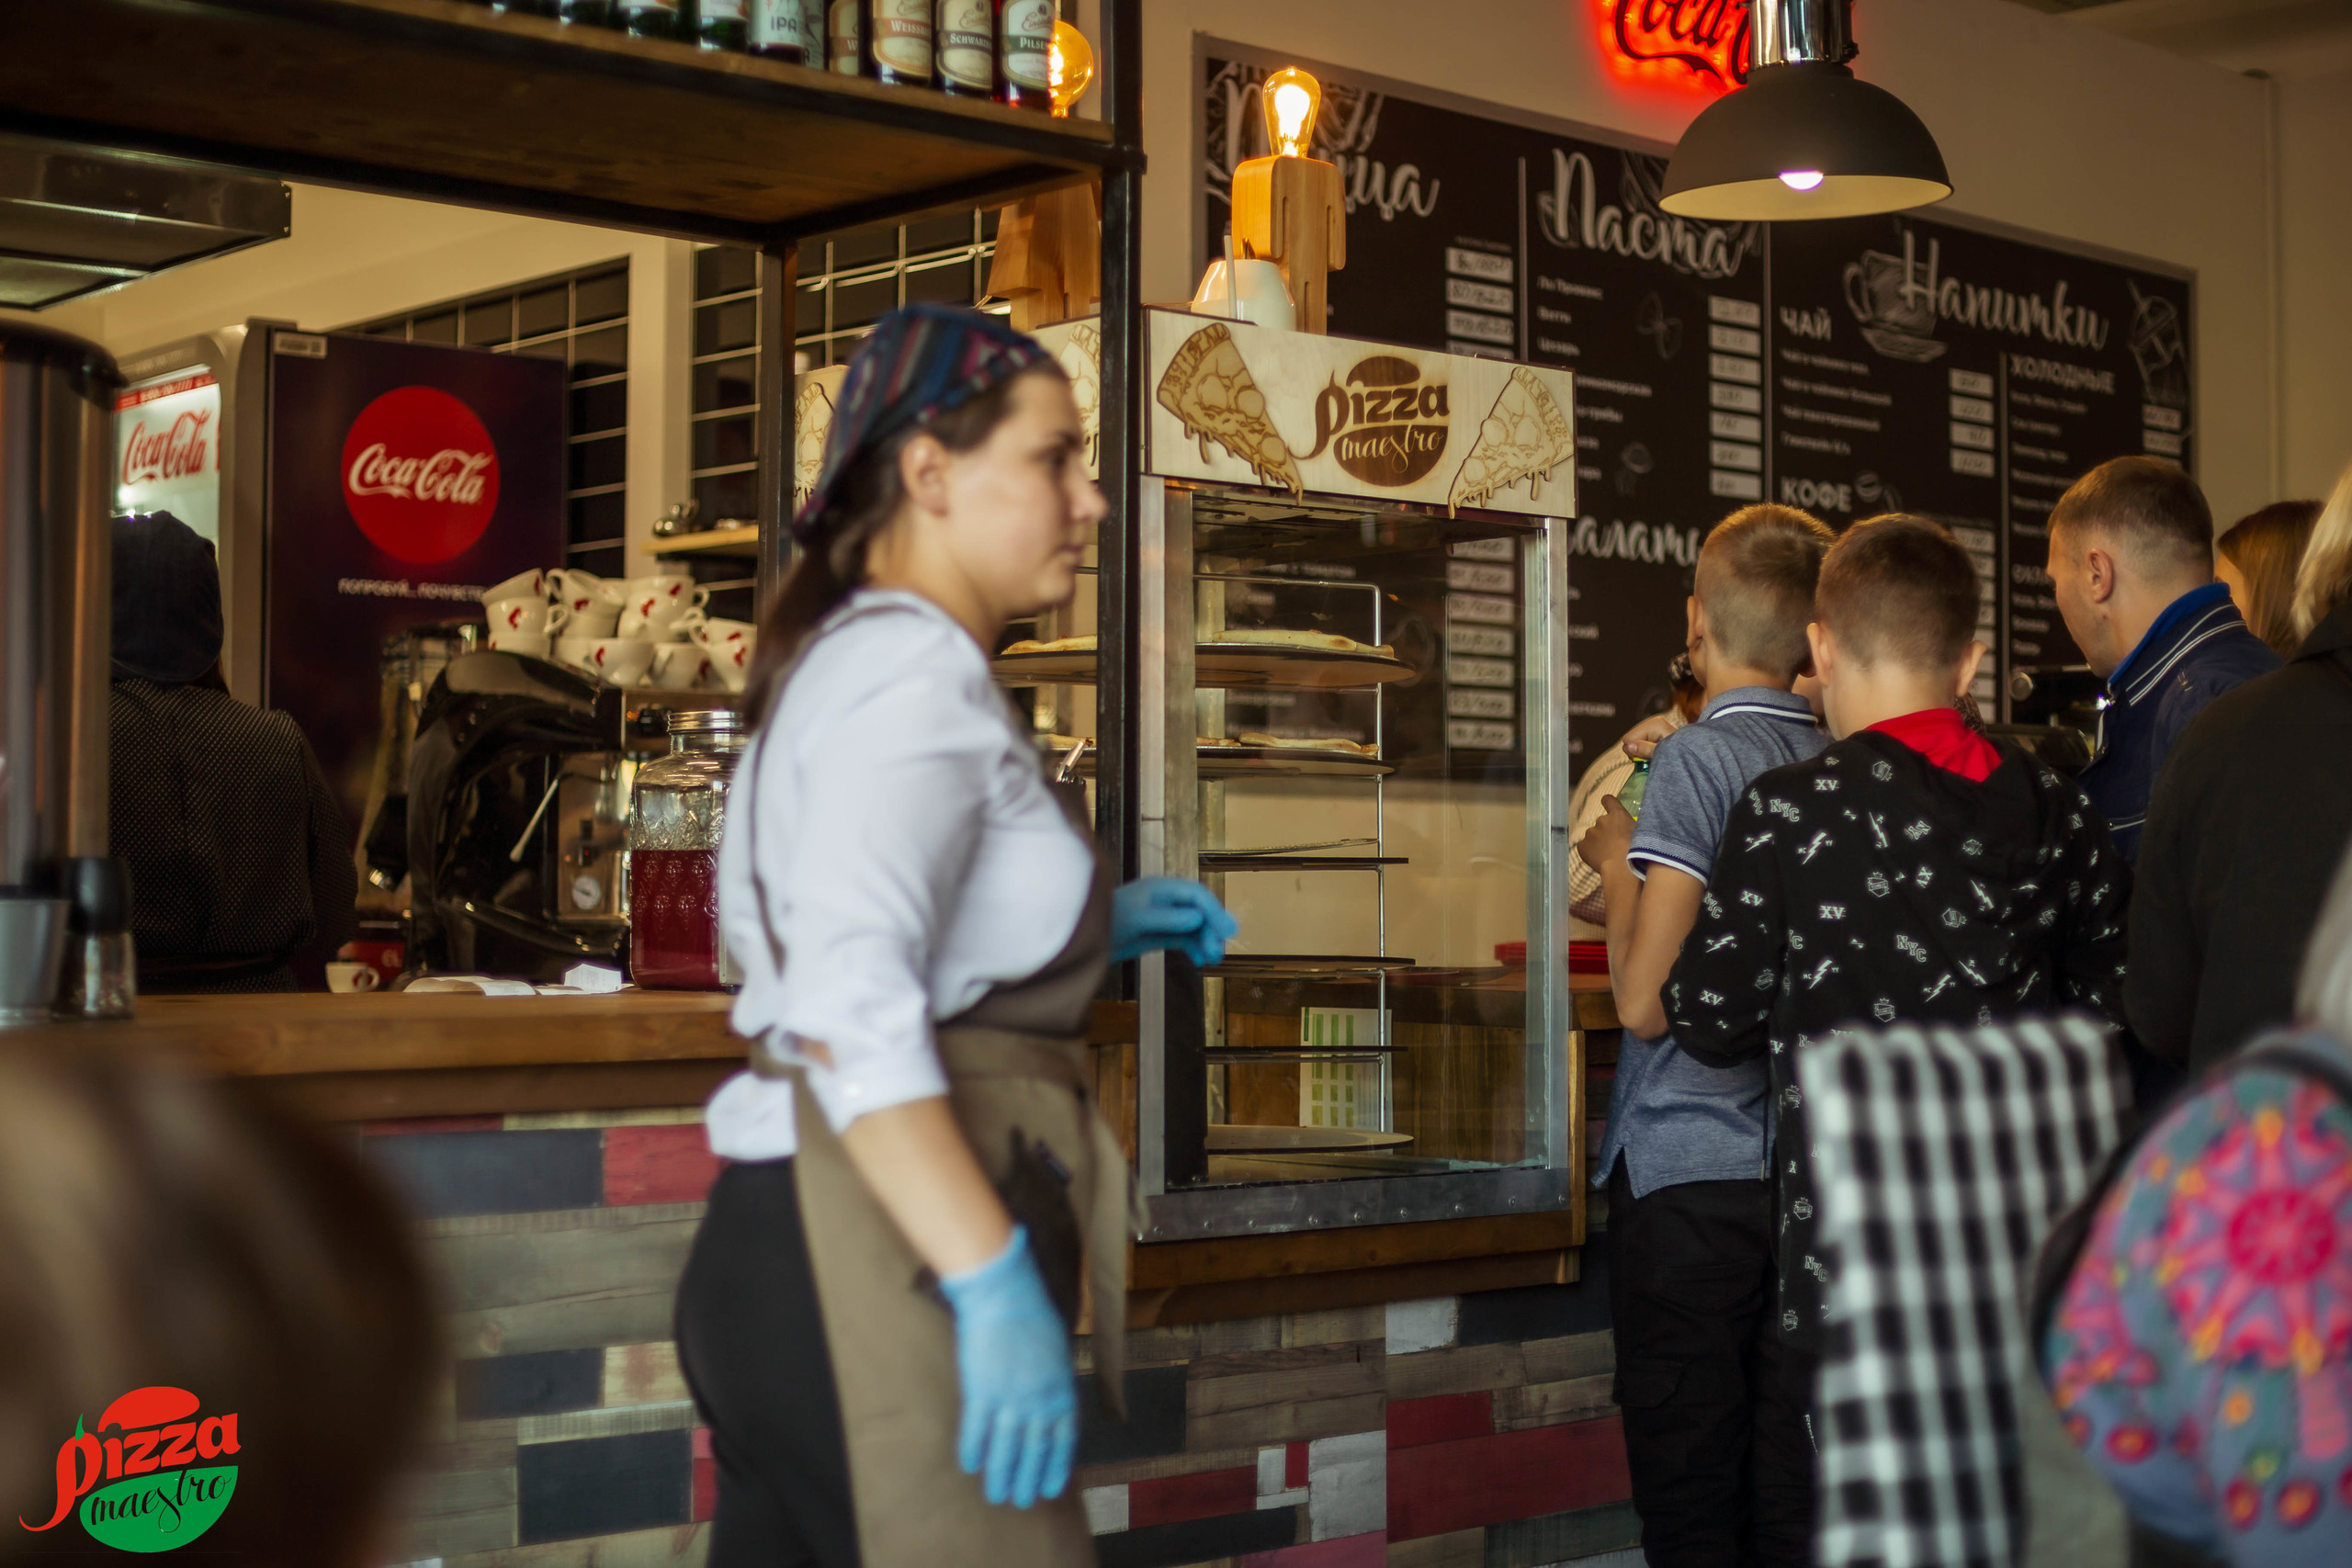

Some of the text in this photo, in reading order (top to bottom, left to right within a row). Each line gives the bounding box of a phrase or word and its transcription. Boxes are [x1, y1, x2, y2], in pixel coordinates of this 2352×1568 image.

[770, 16, 797, 33] IPA
[1551, 147, 1746, 277] Паста
[1899, 230, 2109, 351] Напитки
[1780, 305, 1832, 343] ЧАЙ
[2009, 353, 2114, 395] ХОЛОДНЫЕ
[1341, 423, 1444, 474] maestro
[1781, 477, 1852, 514] КОФЕ
[1815, 779, 1838, 791] XV
[1770, 798, 1800, 822] NYC
[1741, 890, 1763, 907] XV
[1819, 905, 1845, 919] XV
[1896, 934, 1927, 963] NYC
[1700, 989, 1724, 1006] XV
[1804, 1255, 1829, 1282] NYC
